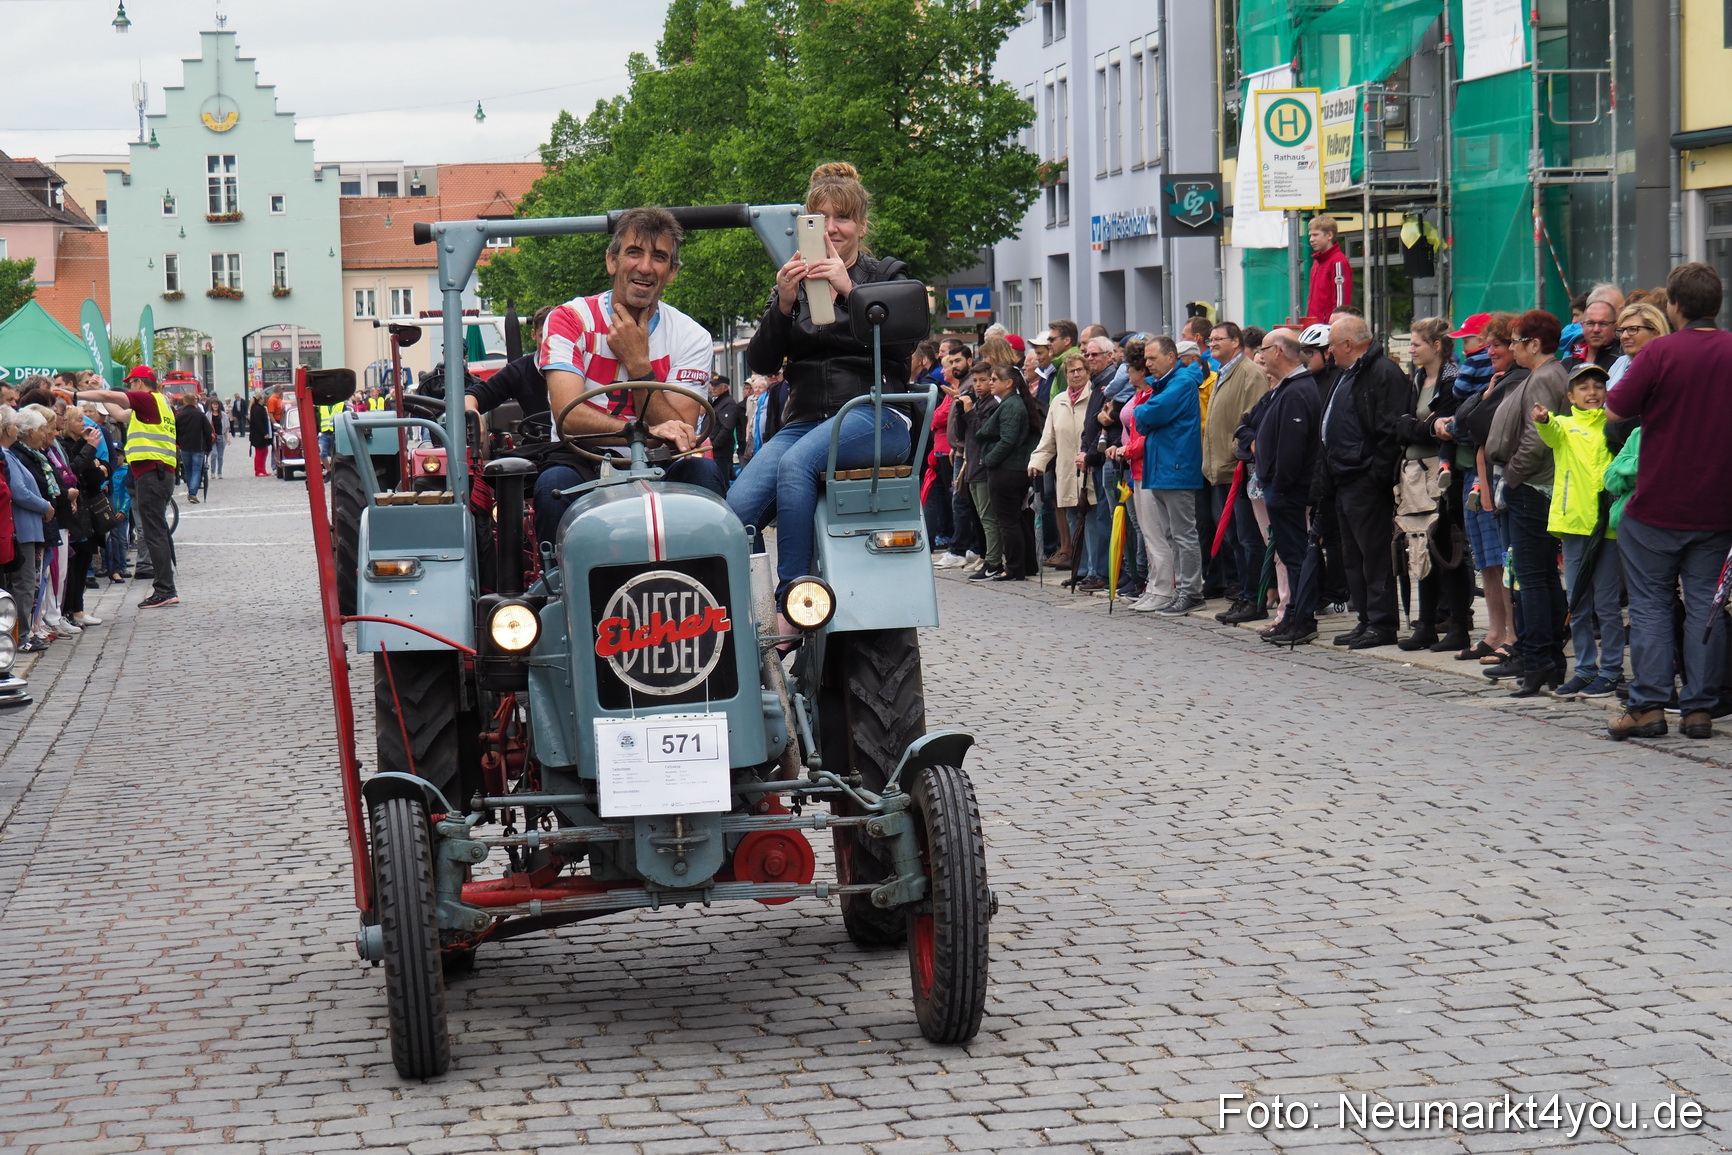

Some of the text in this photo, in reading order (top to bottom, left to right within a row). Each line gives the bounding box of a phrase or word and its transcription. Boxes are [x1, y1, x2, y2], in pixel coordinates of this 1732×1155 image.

[1278, 109, 1298, 136] H
[1326, 133, 1351, 157] Velburg
[1183, 190, 1205, 216] G2
[1103, 211, 1149, 240] Raiffeisenbank
[595, 606, 731, 658] Eicher
[622, 592, 705, 674] DIESEL
[662, 733, 701, 754] 571
